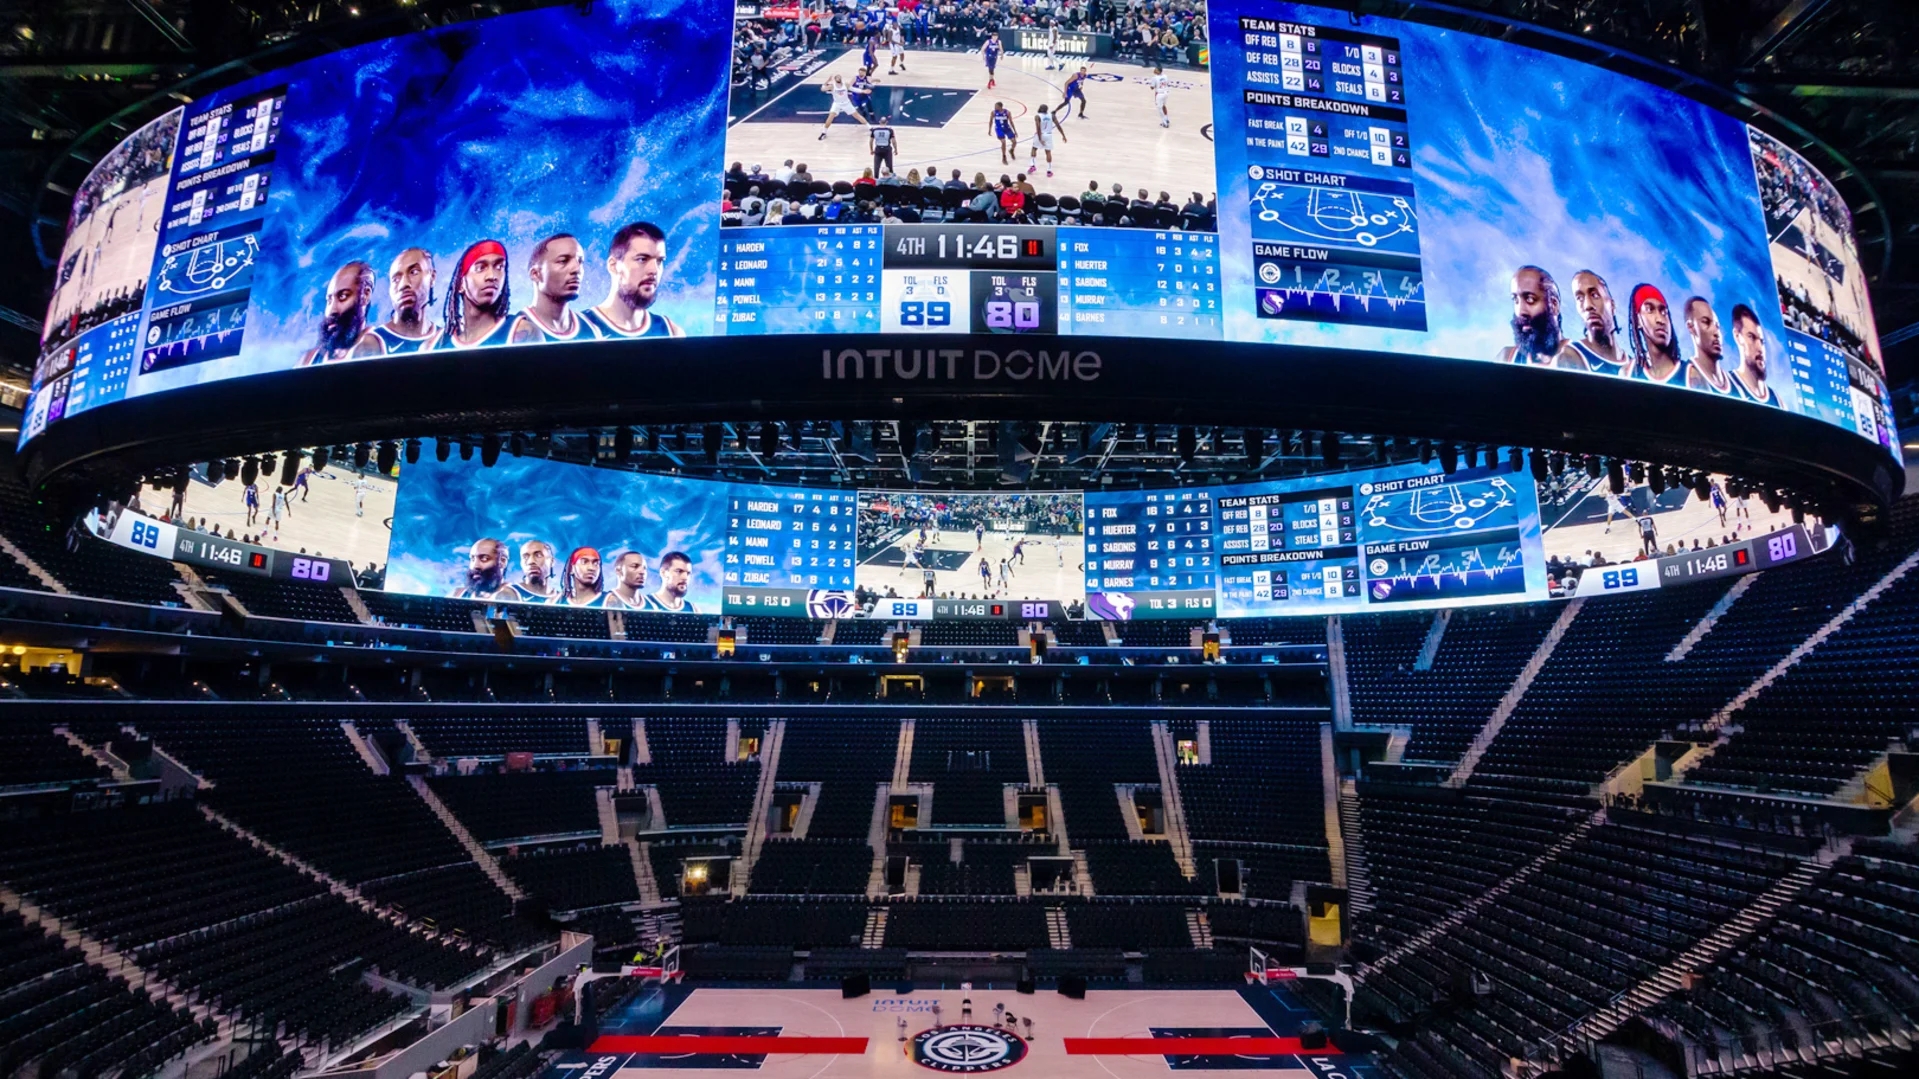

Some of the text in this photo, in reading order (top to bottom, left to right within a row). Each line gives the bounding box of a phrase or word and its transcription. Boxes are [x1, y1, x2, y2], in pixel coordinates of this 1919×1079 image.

[1242, 19, 1315, 37] TEAM STATS
[1245, 34, 1315, 52] OFF REB 8 6
[1246, 52, 1320, 70] DEF REB 28 20
[1344, 46, 1396, 64] T/O 3 8
[1332, 62, 1398, 82] BLOCKS 4 3
[1247, 71, 1320, 89] ASSISTS 22 14
[1336, 81, 1399, 100] STEALS 6 2
[1247, 92, 1369, 116] POINTS BREAKDOWN
[190, 103, 233, 127] TEAM STATS
[1248, 119, 1322, 135] FAST BREAK 12 4
[1344, 129, 1404, 145] OFF T/O 10 2
[1247, 137, 1254, 146] IN
[1255, 138, 1266, 147] THE
[1268, 139, 1285, 149] PAINT
[1290, 142, 1306, 151] 42
[1334, 145, 1406, 163] 2ND CHANCE 8 4
[176, 174, 202, 191] POINTS
[202, 159, 250, 182] BREAKDOWN
[1266, 169, 1347, 186] SHOT CHART
[171, 231, 219, 253] SHOT CHART
[736, 240, 875, 253] HARDEN 17 4 8 2
[896, 237, 925, 255] 4TH
[938, 234, 1017, 259] 11:46
[1074, 243, 1089, 252] FOX
[1255, 244, 1328, 260] GAME FLOW
[735, 258, 873, 270] LEONARD 21 5 4 1
[1075, 260, 1107, 270] HUERTER
[734, 278, 755, 287] MANN
[835, 276, 842, 284] 3
[852, 276, 859, 284] 2
[867, 275, 874, 283] 2
[903, 276, 948, 285] TOL FLS
[991, 276, 1037, 286] TOL FLS
[1075, 278, 1107, 288] SABONIS
[1294, 266, 1413, 291] 1 2 4
[906, 287, 944, 295] 3 0
[995, 287, 1034, 296] 3 0
[733, 293, 874, 305] POWELL 13 2 2 3
[1076, 295, 1105, 305] MURRAY
[151, 303, 192, 322] GAME FLOW
[732, 310, 873, 322] ZUBAC 10 8 1 4
[900, 302, 950, 326] 89
[987, 302, 1040, 328] 80
[1076, 313, 1105, 322] BARNES
[1375, 474, 1445, 492] SHOT CHART
[748, 501, 778, 513] HARDEN
[1220, 496, 1279, 507] TEAM STATS
[1102, 508, 1117, 518] FOX
[746, 519, 782, 530] LEONARD
[1103, 525, 1136, 535] HUERTER
[745, 537, 768, 547] MANN
[1103, 542, 1136, 552] SABONIS
[1367, 541, 1430, 555] GAME FLOW
[131, 520, 330, 582] 89 4TH 11:46 80
[1223, 551, 1323, 564] POINTS BREAKDOWN
[745, 554, 775, 566] POWELL
[1103, 560, 1134, 570] MURRAY
[1603, 532, 1796, 589] 89 4TH 11:46 80
[744, 572, 770, 583] ZUBAC
[1104, 577, 1134, 587] BARNES
[728, 595, 790, 606] TOL 3 FLS 0
[1150, 598, 1212, 609] TOL 3 FLS 0
[892, 603, 1048, 618] 89 4TH 11:46 80
[915, 1026, 1017, 1043] LOS ANGELES
[921, 1059, 1011, 1071] CLIPPERS
[1311, 1058, 1336, 1071] LA
